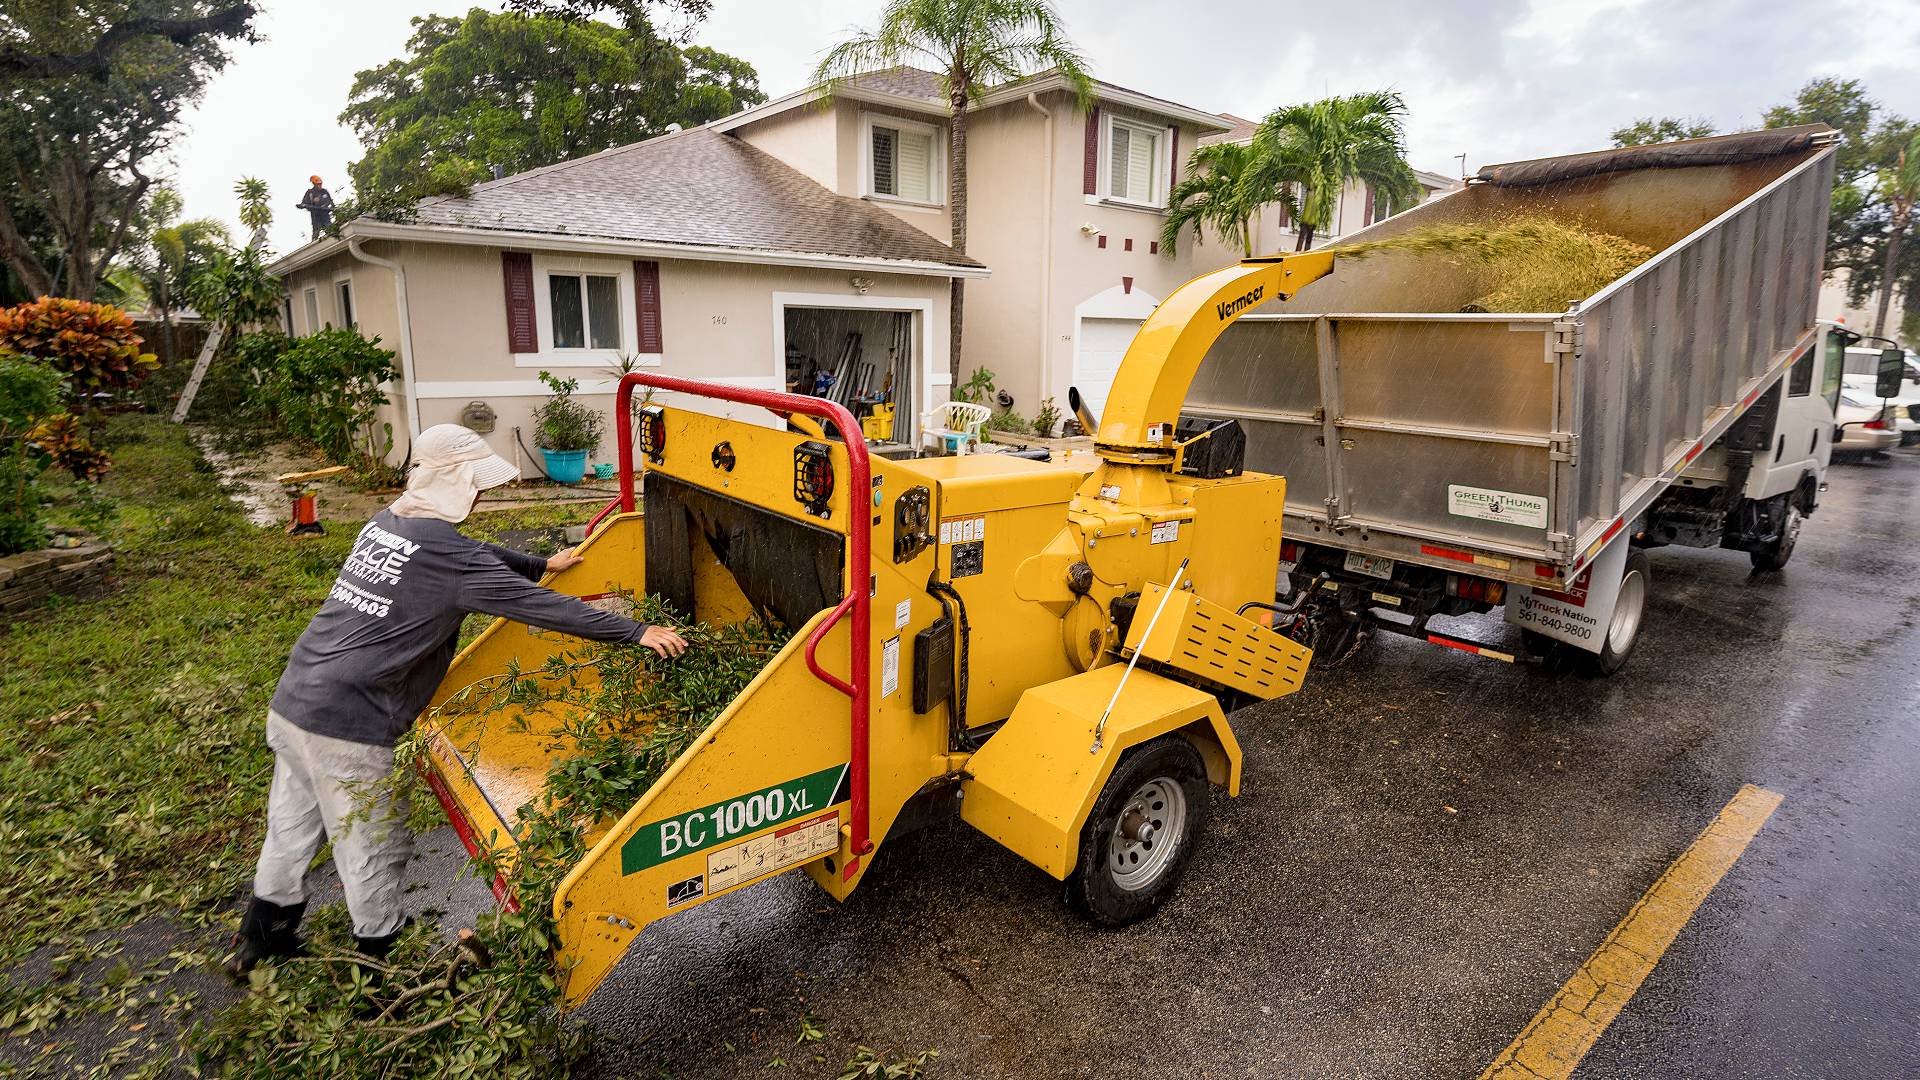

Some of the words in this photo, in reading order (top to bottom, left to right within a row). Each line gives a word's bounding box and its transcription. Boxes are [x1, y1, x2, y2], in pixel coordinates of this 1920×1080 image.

[1216, 285, 1265, 321] Vermeer
[1454, 490, 1495, 502] GREEN
[1496, 495, 1542, 510] THUMB
[1518, 594, 1561, 616] MyTruck
[1562, 608, 1597, 626] Nation
[1518, 609, 1592, 640] 561-840-9800
[786, 787, 814, 816] XL
